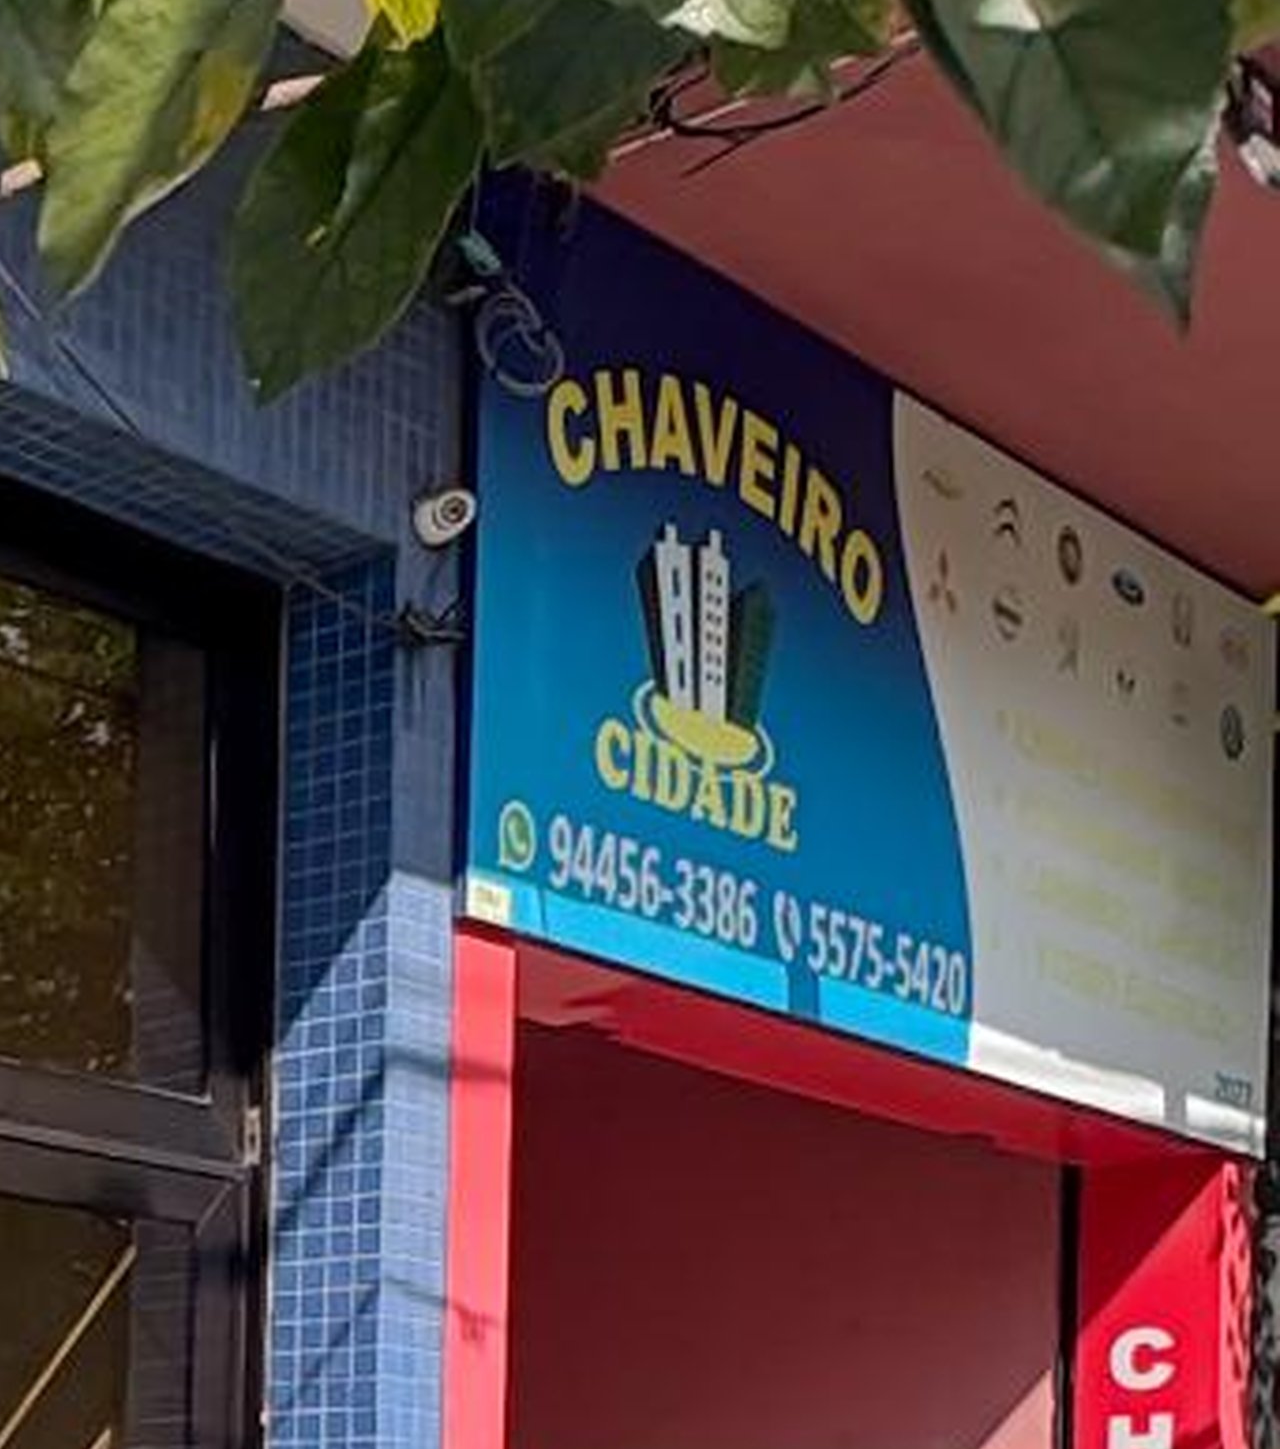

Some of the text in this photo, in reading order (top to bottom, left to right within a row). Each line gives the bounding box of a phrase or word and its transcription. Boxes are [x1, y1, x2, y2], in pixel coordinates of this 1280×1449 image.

[546, 367, 884, 626] CHAVEIRO
[593, 717, 800, 851] CIDADE
[547, 814, 966, 1017] 94456-3386 5575-5420
